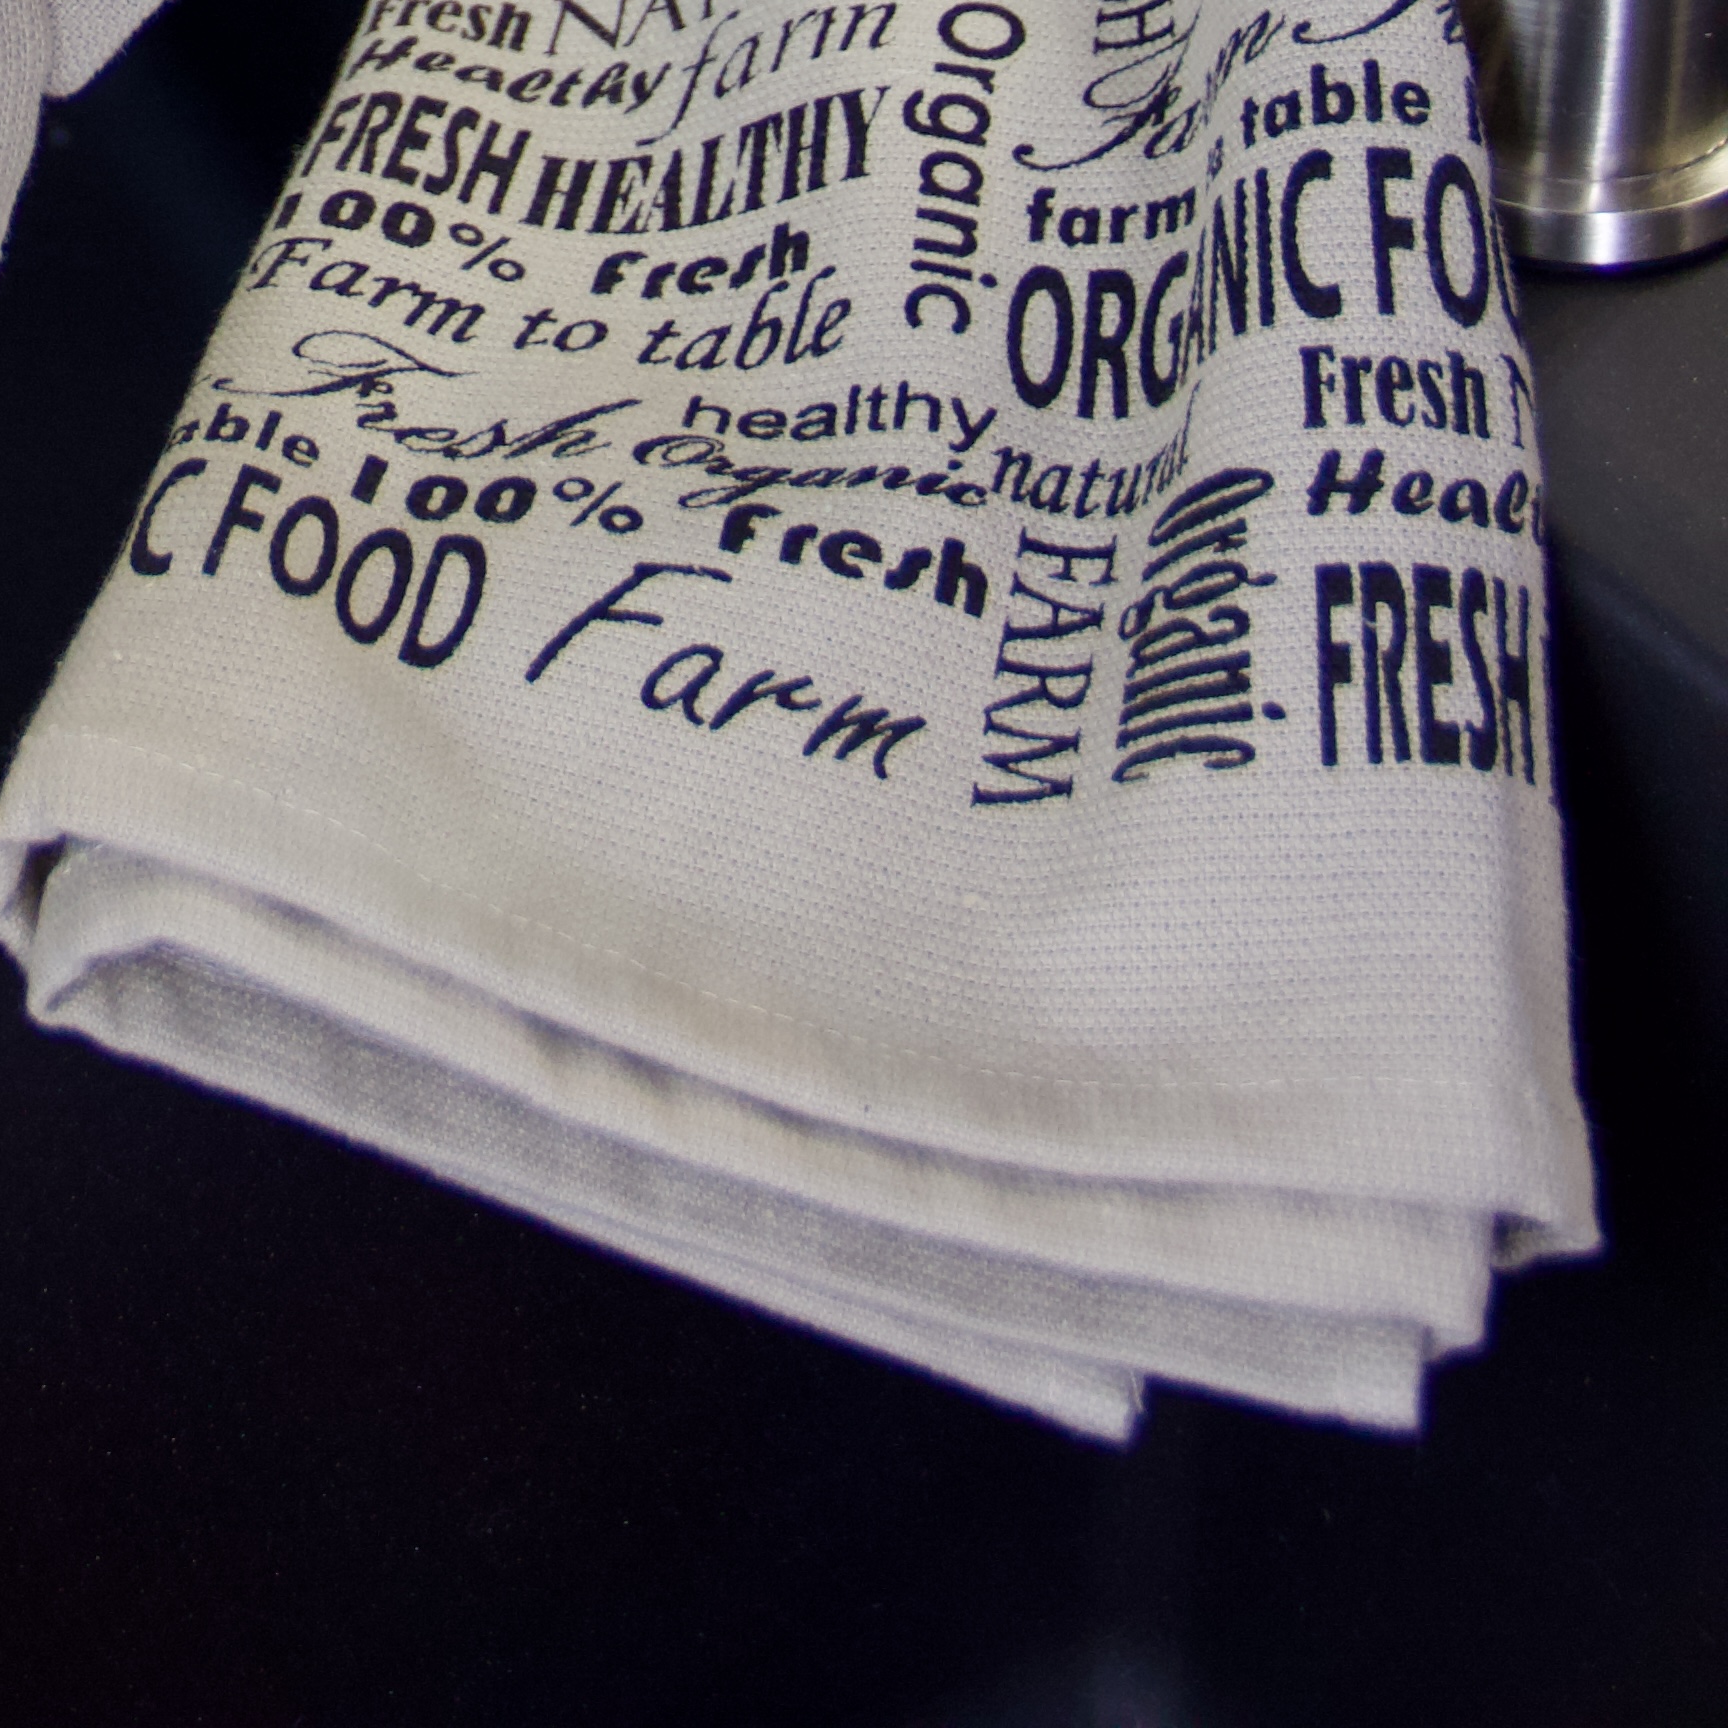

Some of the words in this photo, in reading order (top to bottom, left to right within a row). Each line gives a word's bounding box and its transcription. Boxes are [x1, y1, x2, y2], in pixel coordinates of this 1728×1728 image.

[345, 33, 674, 115] Healthy
[635, 1, 898, 147] farm
[1238, 56, 1432, 149] table
[300, 91, 533, 215] FRESH
[518, 84, 892, 235] HEALTHY
[274, 188, 527, 282] 100%
[1026, 187, 1197, 247] farm
[247, 236, 486, 343] Farm
[513, 307, 610, 353] to
[635, 264, 853, 372] table
[1006, 146, 1343, 419] ORGANIC
[1366, 146, 1524, 346] FO
[681, 379, 1000, 454] healthy
[1298, 345, 1491, 439] Fresh
[350, 454, 645, 535] 100%
[631, 433, 989, 510] Organic
[201, 461, 489, 670] FOOD
[524, 559, 928, 781] Farm
[970, 525, 1120, 808] FARM
[1313, 559, 1538, 787] FRESH
